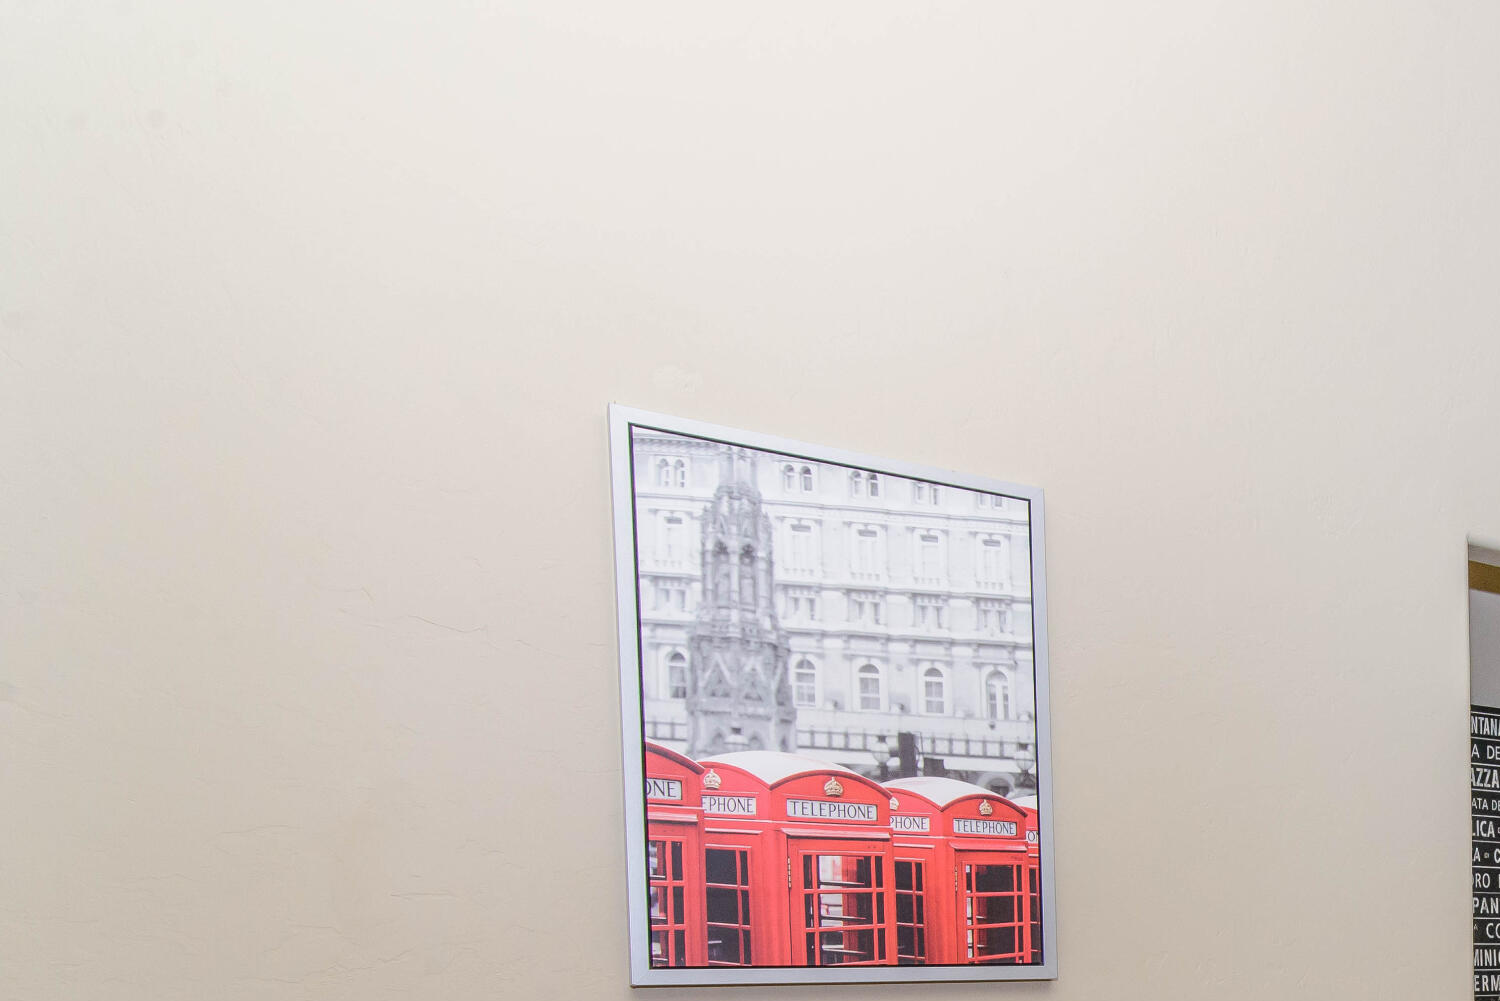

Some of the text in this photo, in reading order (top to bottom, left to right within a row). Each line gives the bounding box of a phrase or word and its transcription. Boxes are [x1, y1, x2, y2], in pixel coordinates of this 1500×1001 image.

[1472, 744, 1480, 758] A
[789, 801, 874, 820] TELEPHONE
[956, 820, 1014, 834] TELEPHONE
[1472, 873, 1490, 888] RO
